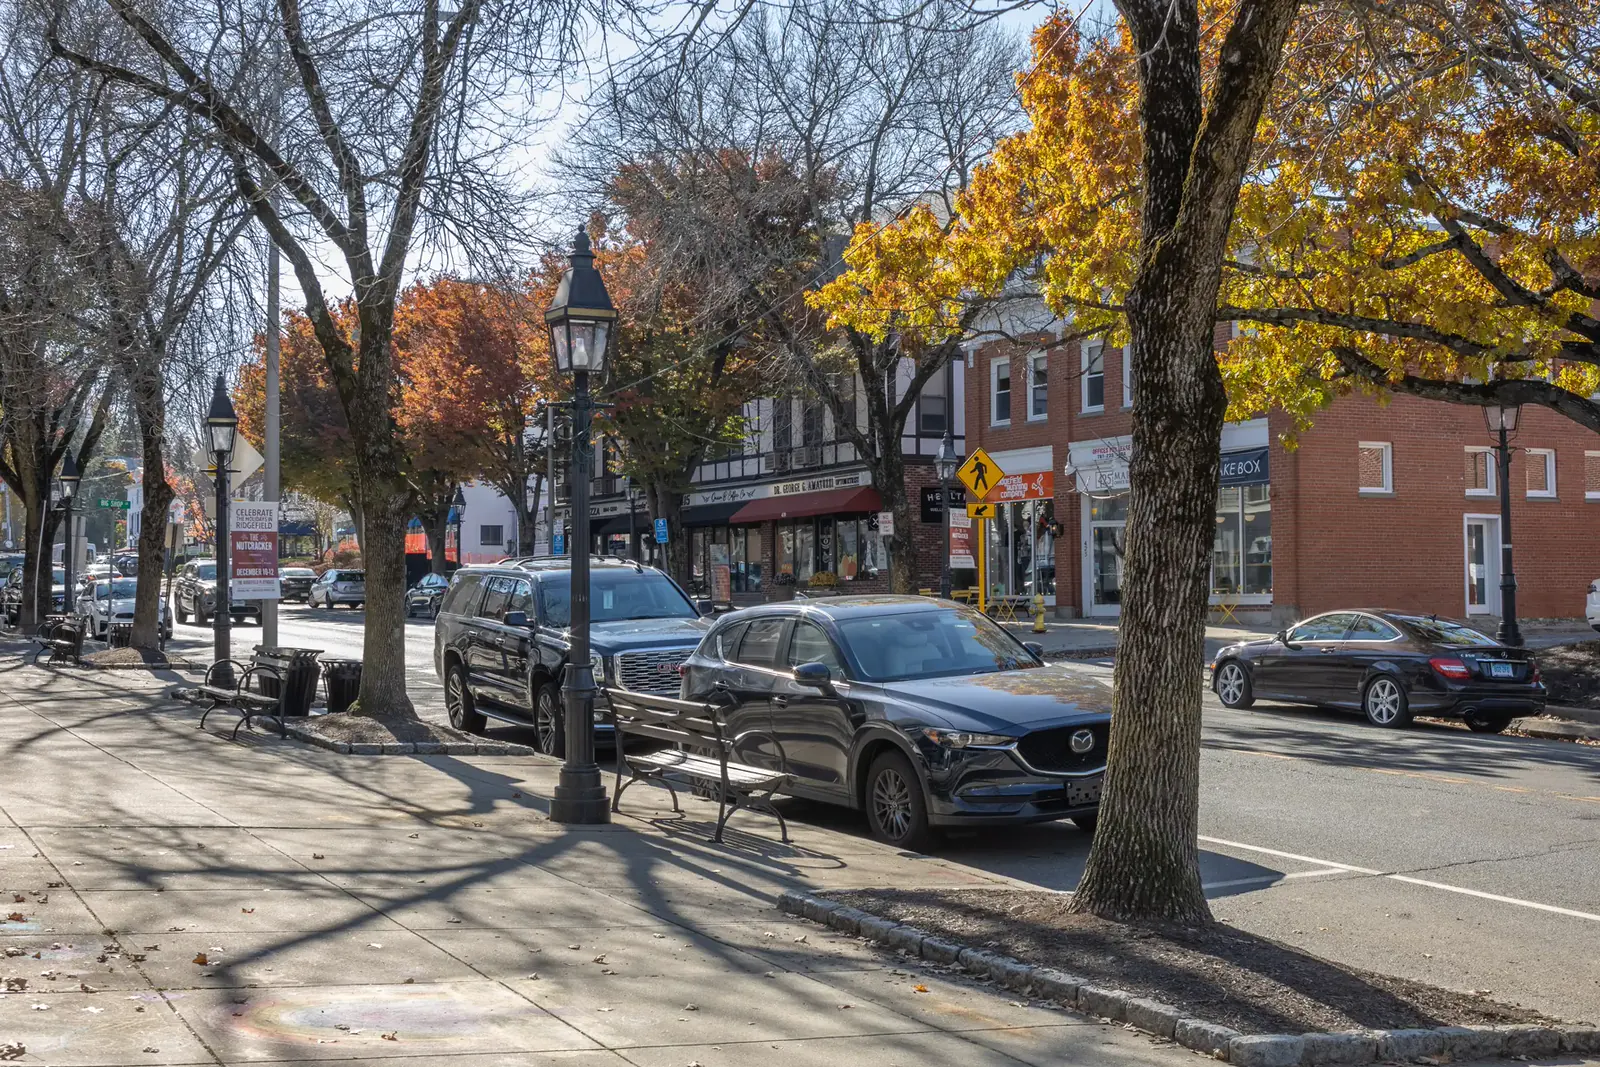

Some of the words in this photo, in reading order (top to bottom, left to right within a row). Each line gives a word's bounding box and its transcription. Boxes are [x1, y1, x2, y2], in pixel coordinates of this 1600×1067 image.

[1092, 447, 1109, 455] OFFICES
[1237, 460, 1261, 474] BOX
[774, 485, 782, 495] DR.
[783, 483, 800, 493] GEORGE
[1000, 490, 1026, 499] company
[236, 508, 273, 517] CELEBRATE
[250, 533, 259, 541] THE
[236, 541, 273, 551] NUTCRACKER
[236, 568, 262, 576] DECEMBER
[657, 661, 681, 674] GM
